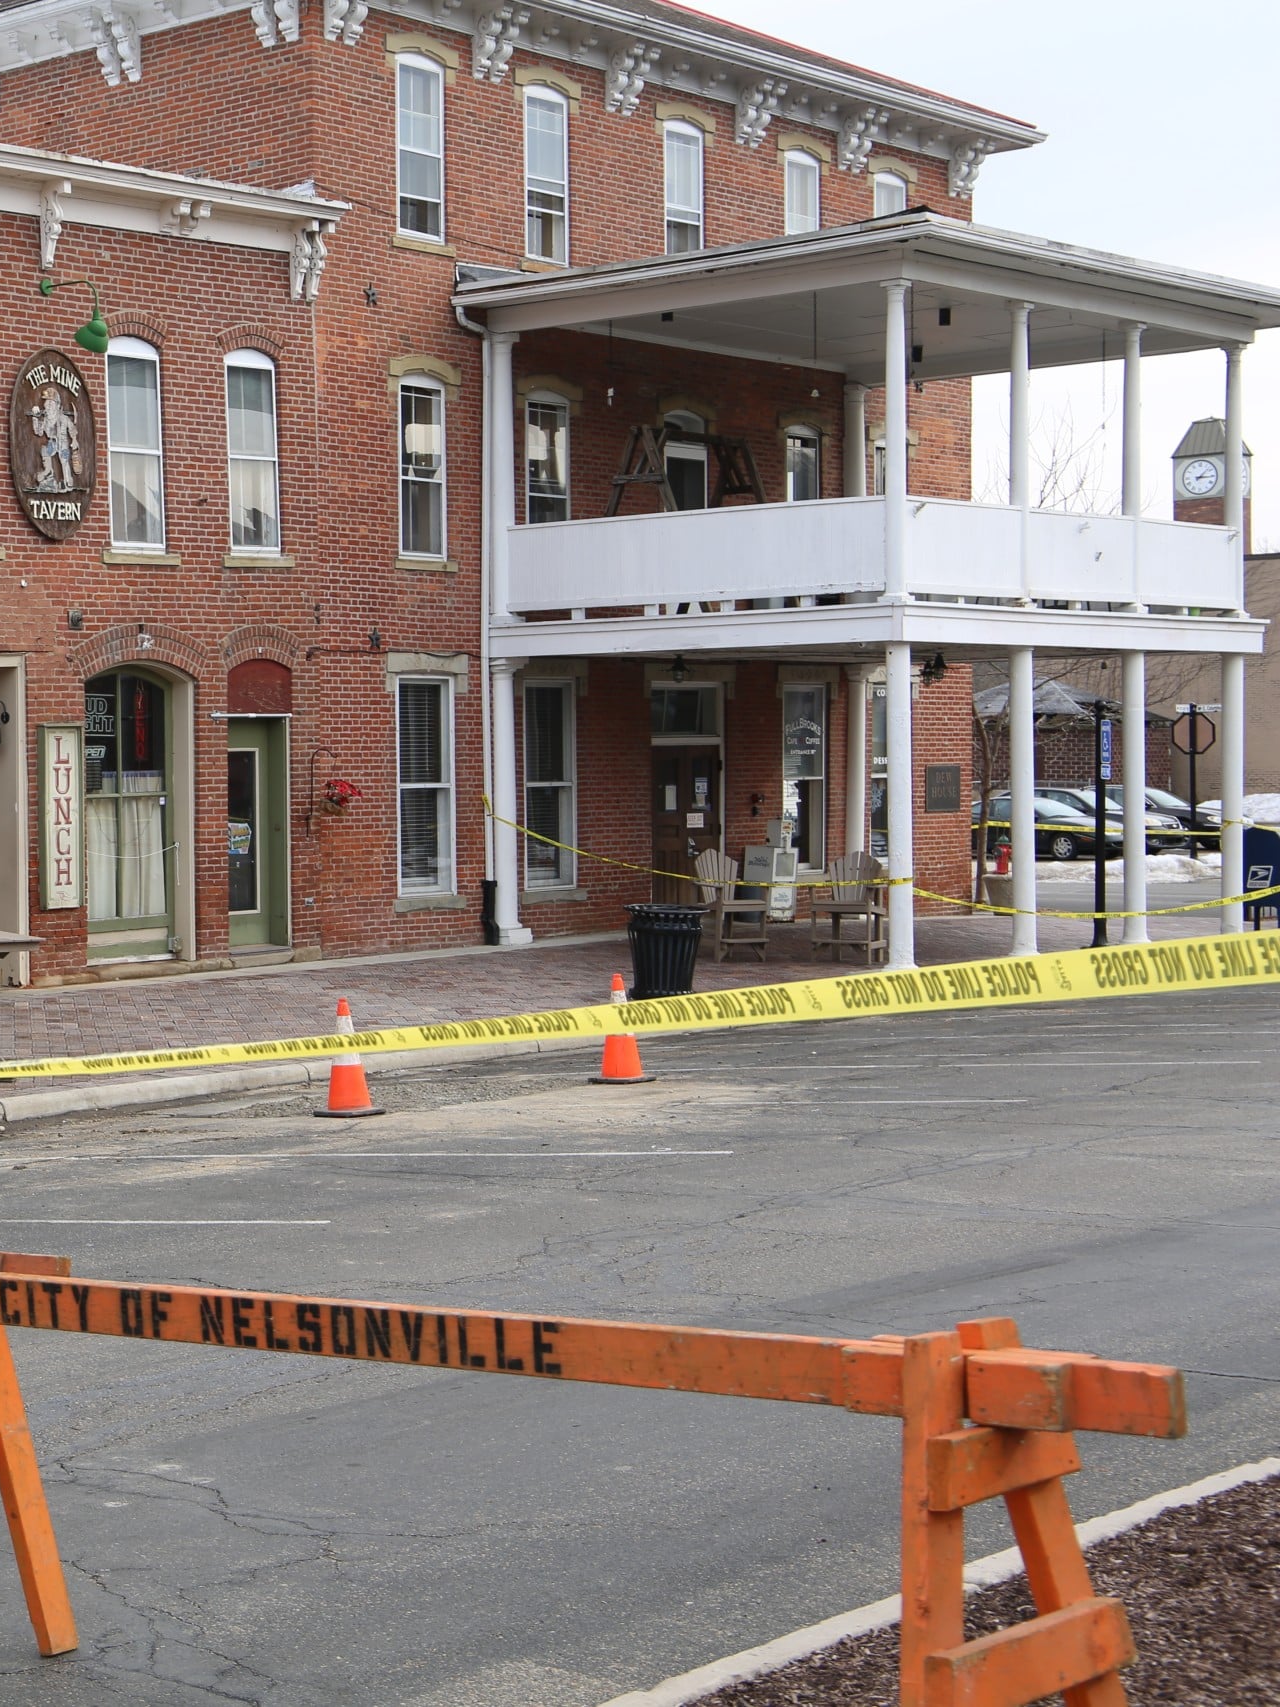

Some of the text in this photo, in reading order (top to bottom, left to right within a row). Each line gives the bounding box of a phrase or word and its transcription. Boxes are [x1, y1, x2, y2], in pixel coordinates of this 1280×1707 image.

[26, 364, 82, 397] THE MINE
[30, 500, 82, 521] TAVERN
[84, 697, 108, 714] UD
[931, 787, 957, 798] HOUSE
[53, 735, 73, 886] LUNCH
[121, 1289, 173, 1339] OF
[199, 1295, 563, 1375] NELSONVILLE
